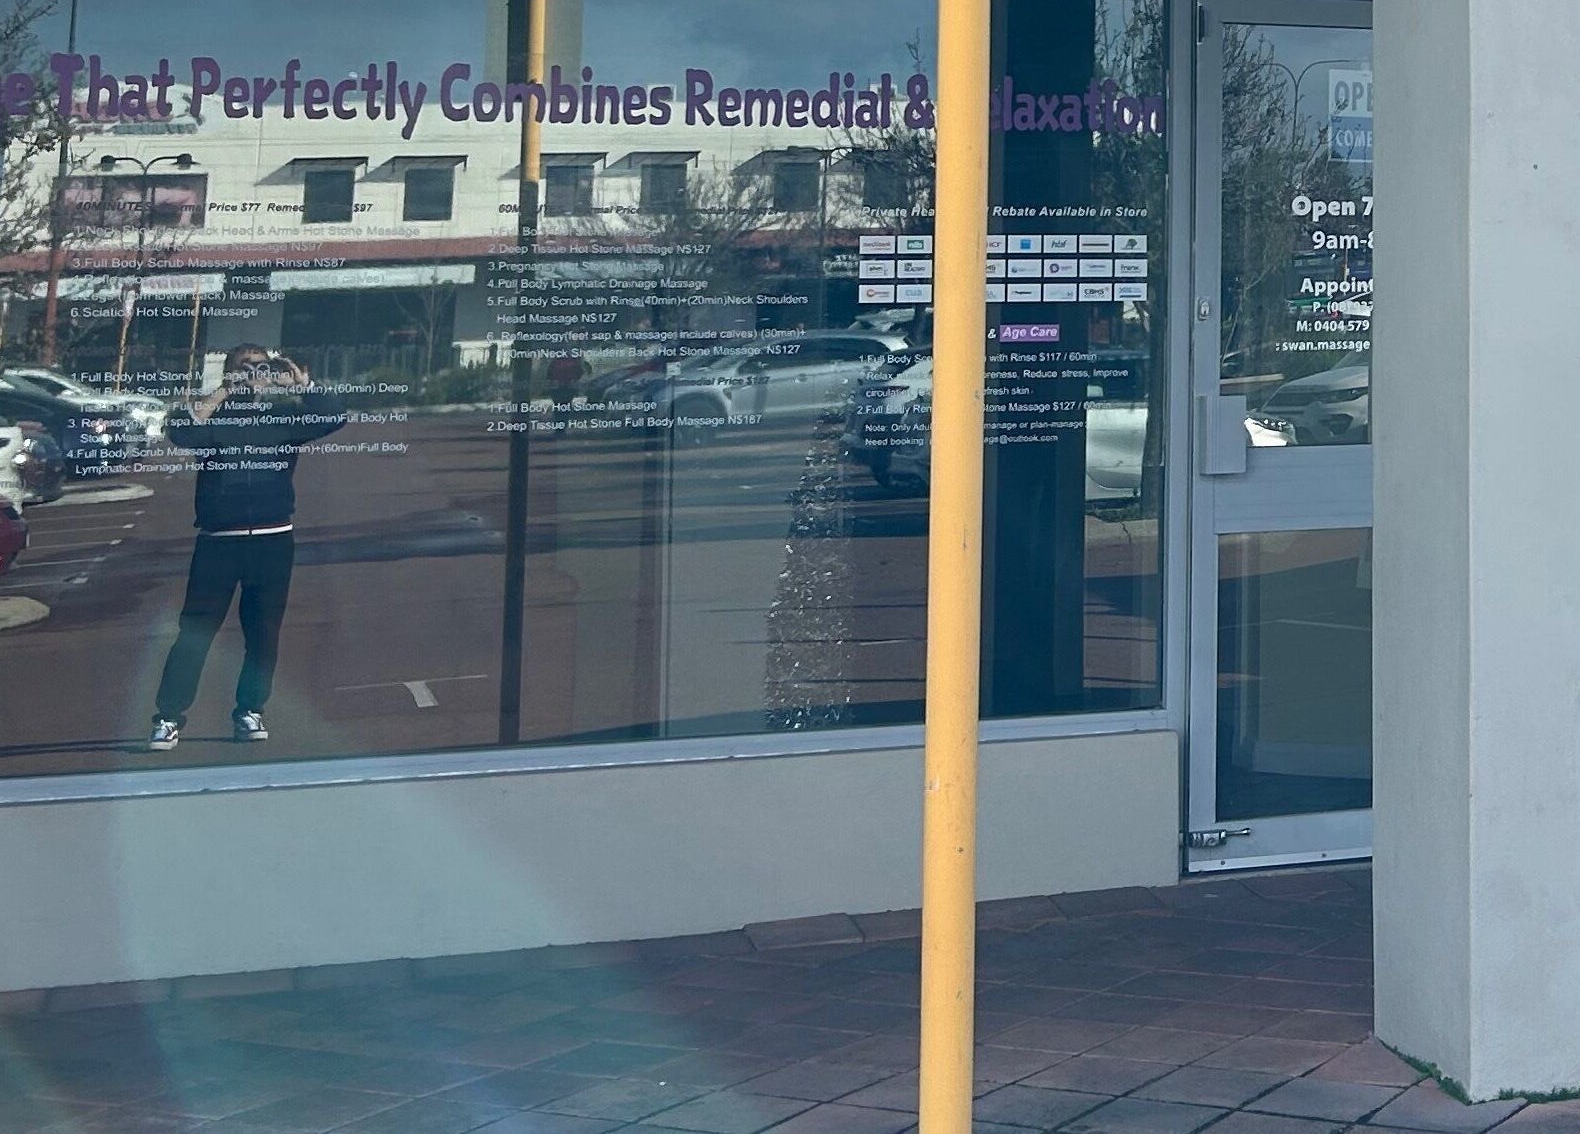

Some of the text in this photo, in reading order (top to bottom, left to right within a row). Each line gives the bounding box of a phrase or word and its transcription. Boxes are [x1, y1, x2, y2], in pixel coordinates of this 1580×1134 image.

[50, 52, 174, 117] That
[190, 55, 427, 139] Perfectly
[440, 62, 672, 125] Combines
[685, 68, 892, 129] Remedial
[904, 72, 935, 130] &
[209, 202, 238, 212] Price
[241, 202, 262, 212] $77
[992, 206, 1036, 217] Rebate
[1039, 206, 1097, 217] Available
[1100, 206, 1112, 217] in
[1115, 206, 1149, 218] Store
[1291, 195, 1356, 223] Open
[112, 258, 143, 270] Body
[148, 258, 185, 268] Scrub
[188, 258, 243, 270] Massage
[246, 258, 271, 268] with
[275, 257, 311, 268] Rinse
[520, 280, 548, 290] Body
[551, 279, 606, 290] Lymphatic
[660, 278, 708, 290] Massage
[230, 290, 285, 302] Massage
[520, 294, 809, 307] Body Scrub with Shoulders
[136, 307, 159, 317] Hot
[202, 306, 259, 319] Massage
[497, 314, 526, 323] Head
[529, 314, 579, 324] Massage
[1314, 320, 1345, 332] 0404
[1347, 320, 1370, 332] 579
[987, 328, 996, 339] &
[1003, 326, 1058, 339] Age Care
[887, 355, 912, 366] Body
[1010, 353, 1037, 362] Rinse
[104, 371, 192, 383] Body Hot Stone
[1023, 369, 1058, 379] Reduce
[138, 383, 408, 396] Scrub with Deep
[225, 400, 273, 412] Massage
[609, 401, 657, 412] Massage
[1008, 402, 1051, 413] Massage
[362, 413, 387, 424] Body
[568, 420, 588, 429] Hot
[591, 418, 622, 429] Stone
[625, 418, 644, 427] Full
[647, 417, 674, 429] Body
[677, 416, 724, 428] Massage
[100, 443, 410, 460] Body Scrub Massage with Body
[134, 463, 182, 475] Drainage
[186, 462, 204, 471] Hot
[207, 460, 238, 471] Stone
[240, 460, 289, 472] Massage
